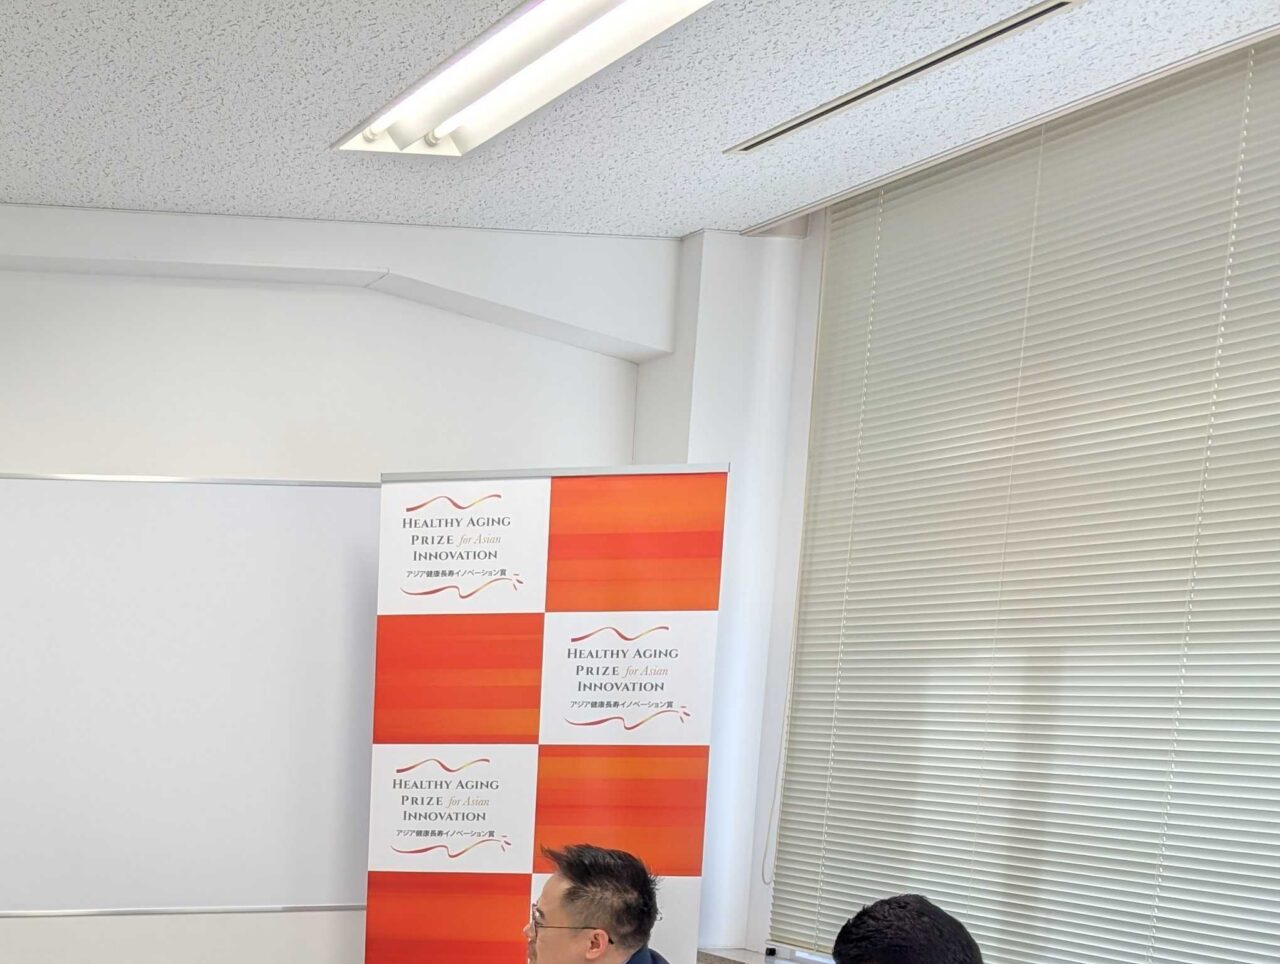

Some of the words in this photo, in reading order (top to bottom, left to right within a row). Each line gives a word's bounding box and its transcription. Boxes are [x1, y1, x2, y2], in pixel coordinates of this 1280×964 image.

[402, 517, 463, 529] HEALTHY
[466, 516, 511, 527] AGING
[411, 534, 454, 546] PRIZE
[456, 533, 473, 547] for
[474, 533, 502, 545] Asian
[413, 550, 498, 562] INNOVATION
[406, 568, 507, 578] アジア健康長寿イノベーション賞
[567, 648, 629, 659] HEALTHY
[632, 648, 679, 659] AGING
[575, 665, 619, 676] PRIZE
[621, 665, 638, 679] for
[639, 665, 669, 676] Asian
[577, 681, 665, 692] INNOVATION
[570, 700, 674, 709] アジア健康長寿イノベーション賞
[392, 778, 452, 790] HEALTHY
[455, 779, 499, 790] AGING
[401, 795, 443, 806] PRIZE
[445, 796, 462, 809] for
[462, 796, 490, 806] Asian
[403, 811, 486, 822] INNOVATION
[396, 829, 495, 837] アジア健康長寿イノベーション賞
